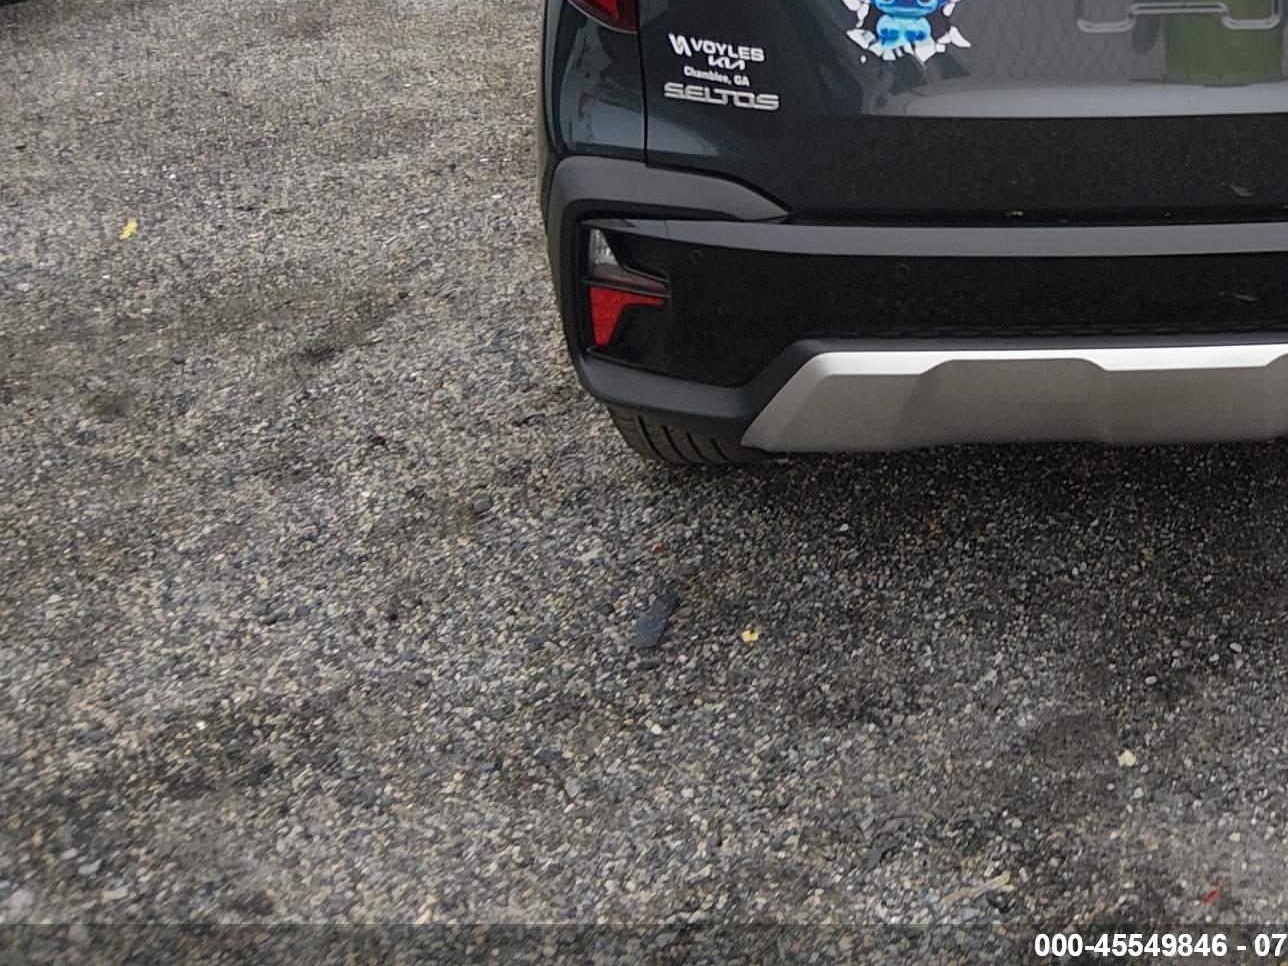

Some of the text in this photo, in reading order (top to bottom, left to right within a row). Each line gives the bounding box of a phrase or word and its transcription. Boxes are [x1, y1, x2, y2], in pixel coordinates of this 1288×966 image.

[690, 37, 765, 62] VOYLES
[708, 55, 746, 71] KIA
[733, 74, 750, 87] GA
[663, 81, 780, 111] SELTOS
